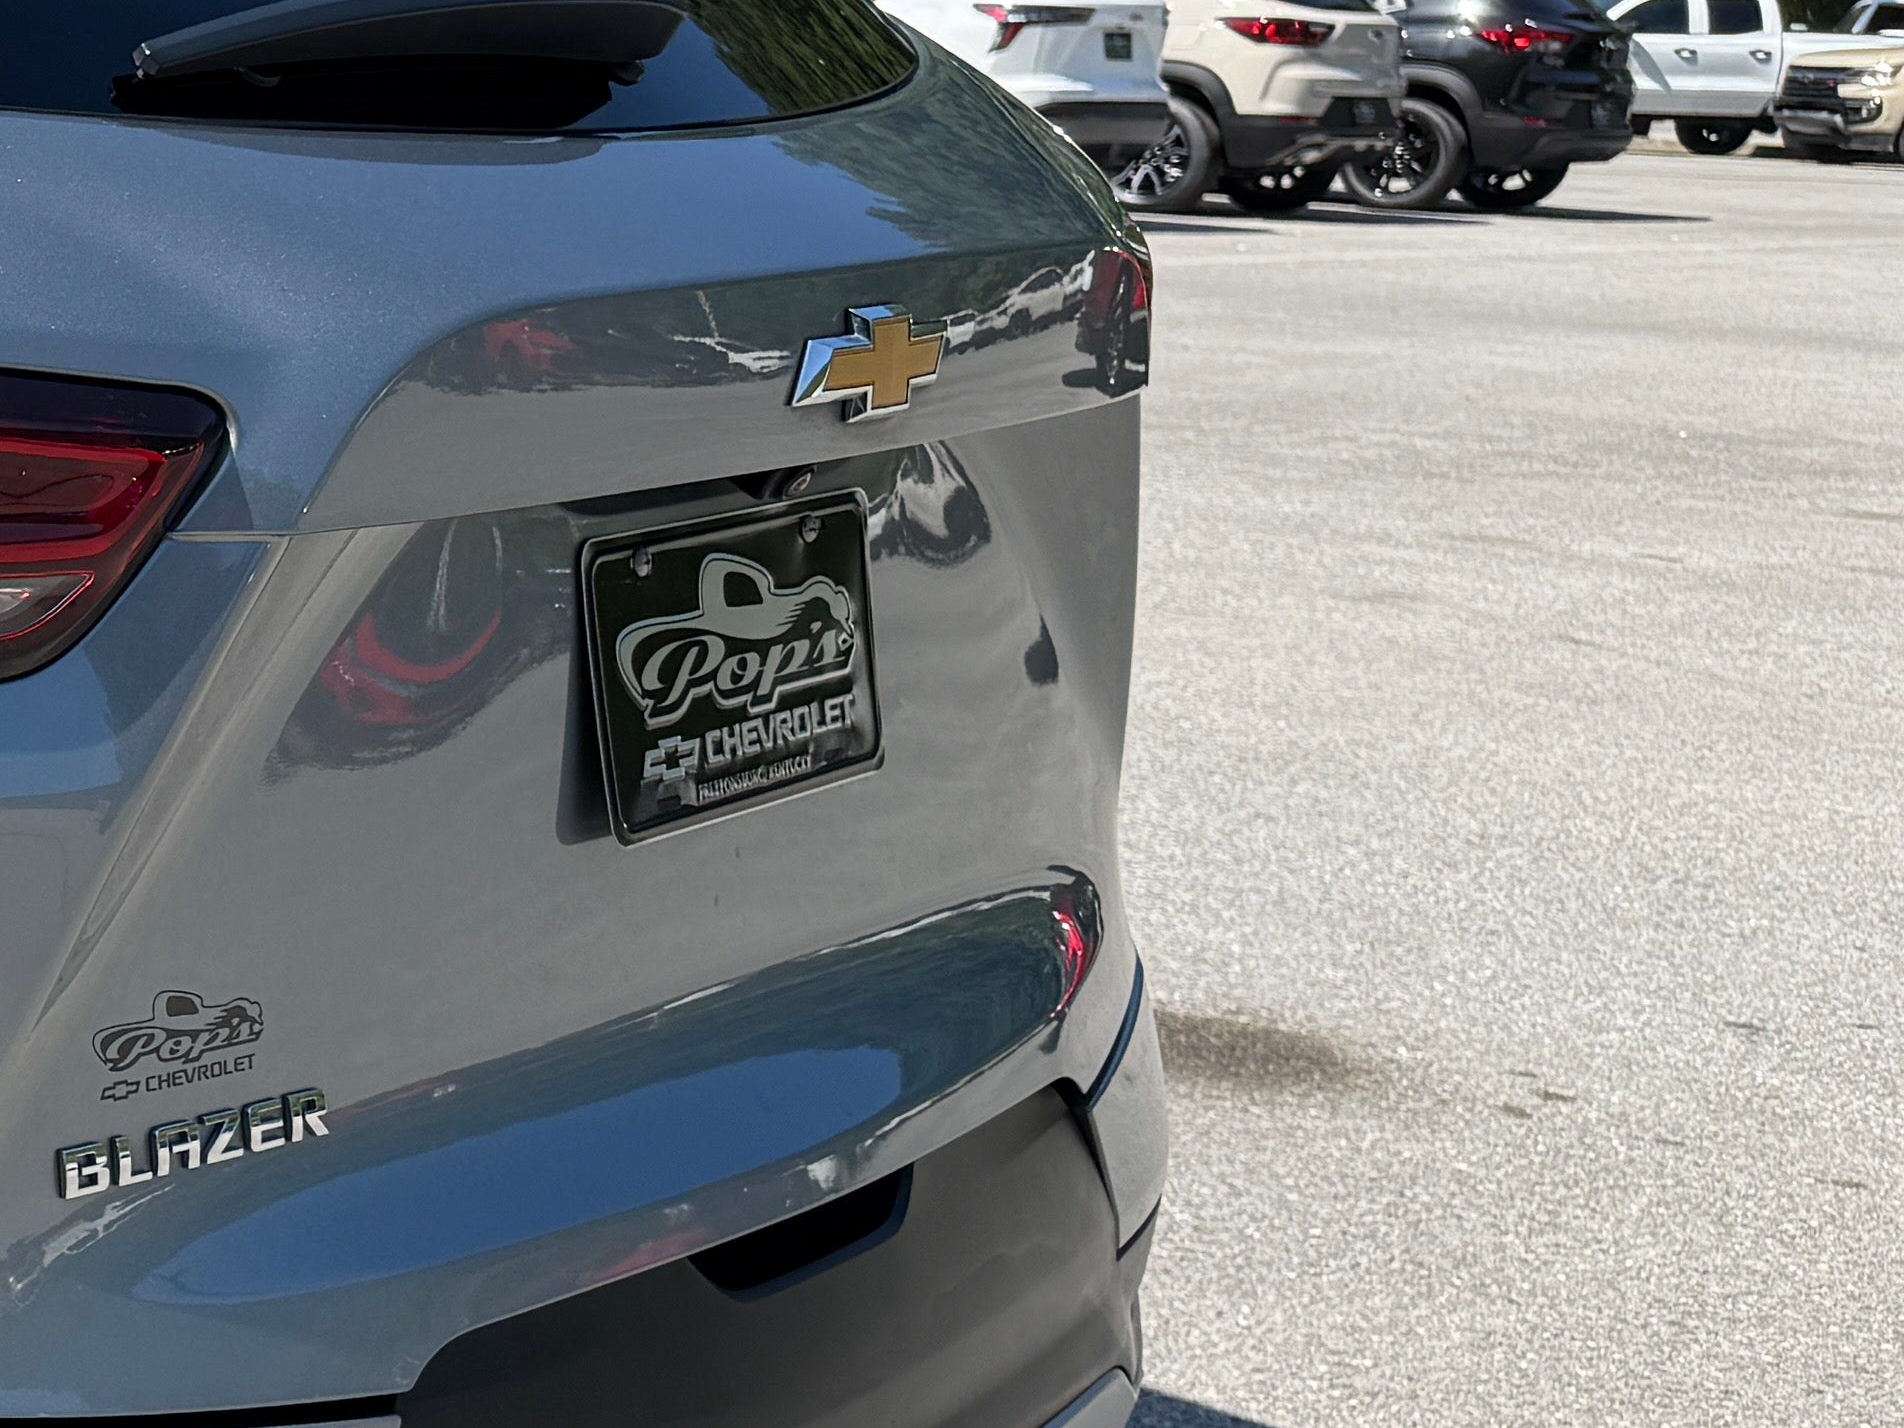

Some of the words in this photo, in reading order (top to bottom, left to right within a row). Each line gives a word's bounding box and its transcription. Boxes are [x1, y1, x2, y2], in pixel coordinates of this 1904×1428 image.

[640, 620, 847, 709] Pop's
[704, 693, 855, 766] CHEVROLET
[104, 1018, 259, 1072] Pop's
[145, 1052, 256, 1093] CHEVROLET
[59, 1086, 331, 1201] BLAZER
